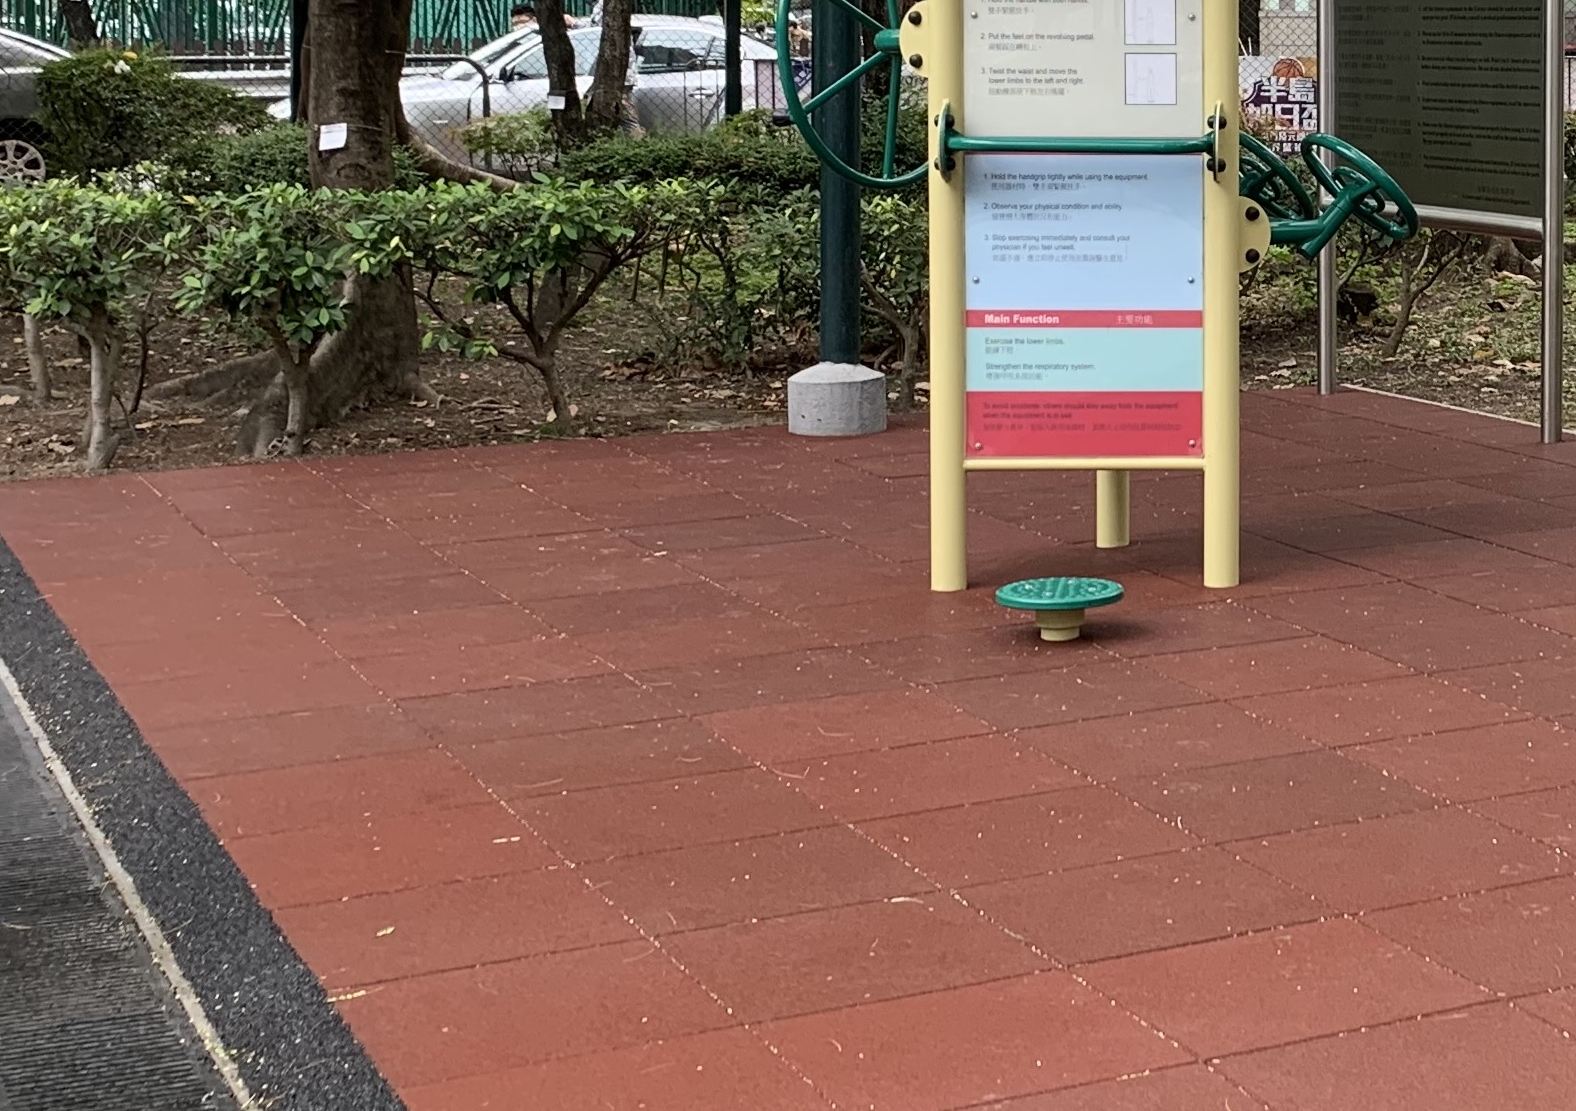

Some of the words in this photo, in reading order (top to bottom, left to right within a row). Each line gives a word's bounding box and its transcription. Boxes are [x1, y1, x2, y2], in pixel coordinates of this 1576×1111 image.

[1259, 75, 1315, 103] 半島
[984, 314, 1010, 324] Main
[1013, 314, 1060, 324] Function
[1116, 315, 1153, 325] 主要功能
[985, 363, 1022, 372] Strengthen
[1034, 363, 1070, 372] respiratory
